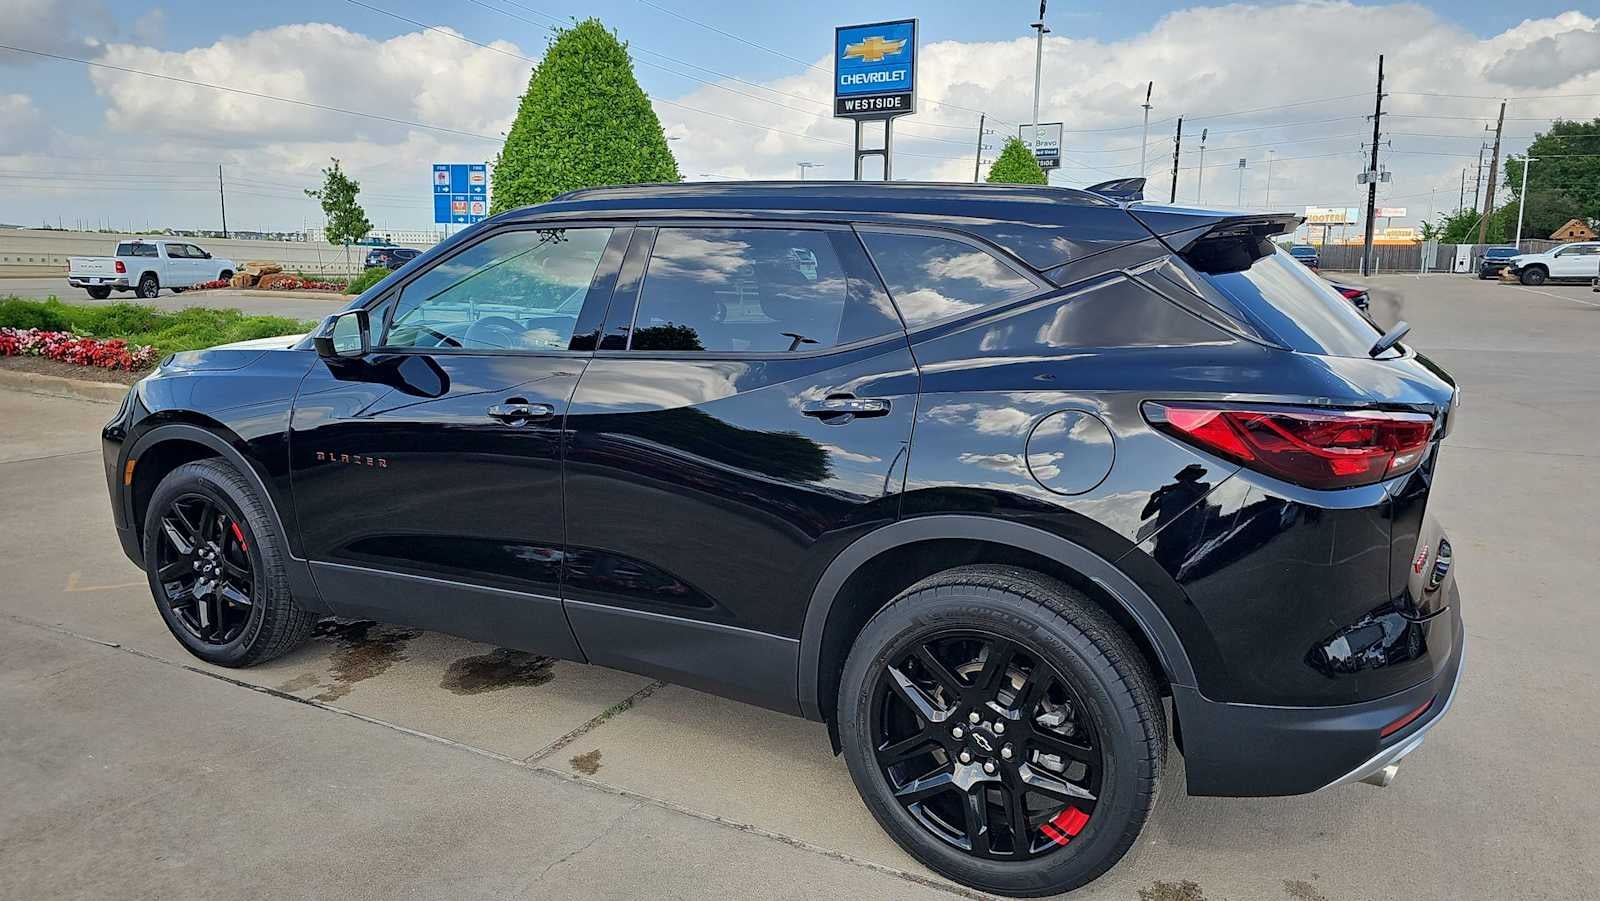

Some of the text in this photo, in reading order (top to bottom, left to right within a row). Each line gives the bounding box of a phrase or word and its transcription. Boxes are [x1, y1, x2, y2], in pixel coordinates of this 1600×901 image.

[841, 70, 906, 85] CHEVROLET
[845, 97, 901, 110] WESTSIDE
[316, 451, 388, 468] BLAZER
